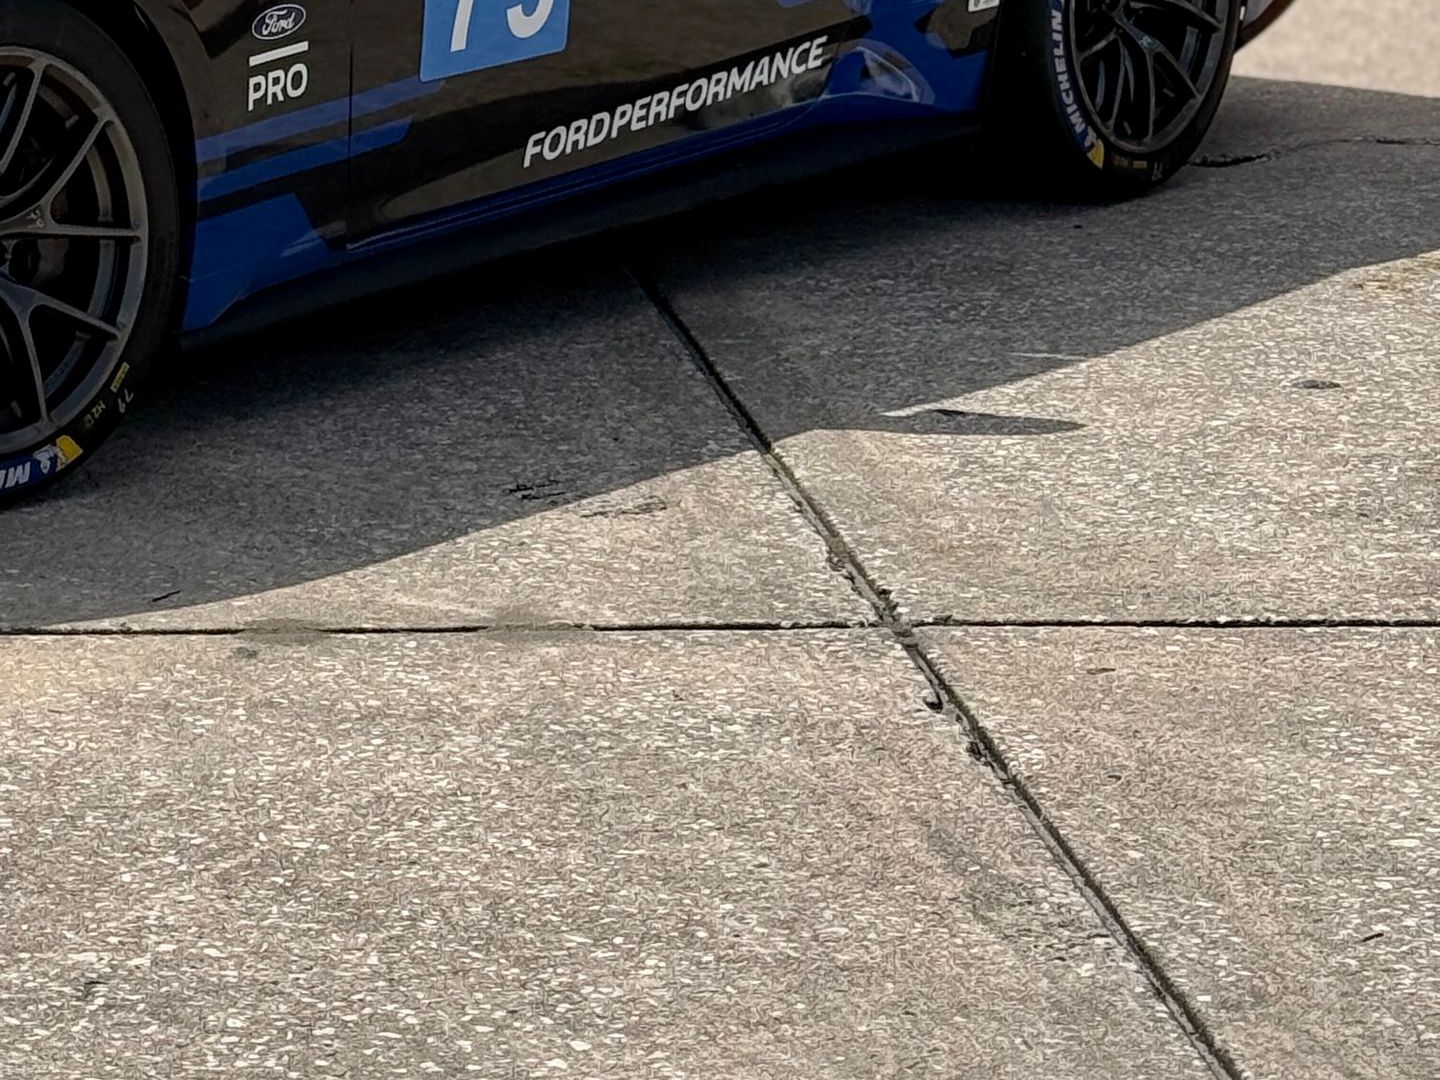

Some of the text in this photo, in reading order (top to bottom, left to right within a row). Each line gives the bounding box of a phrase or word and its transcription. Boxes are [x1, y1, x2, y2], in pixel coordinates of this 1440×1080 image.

[261, 6, 297, 37] Ford
[248, 62, 308, 112] PRO
[1051, 9, 1087, 137] MICHELIN
